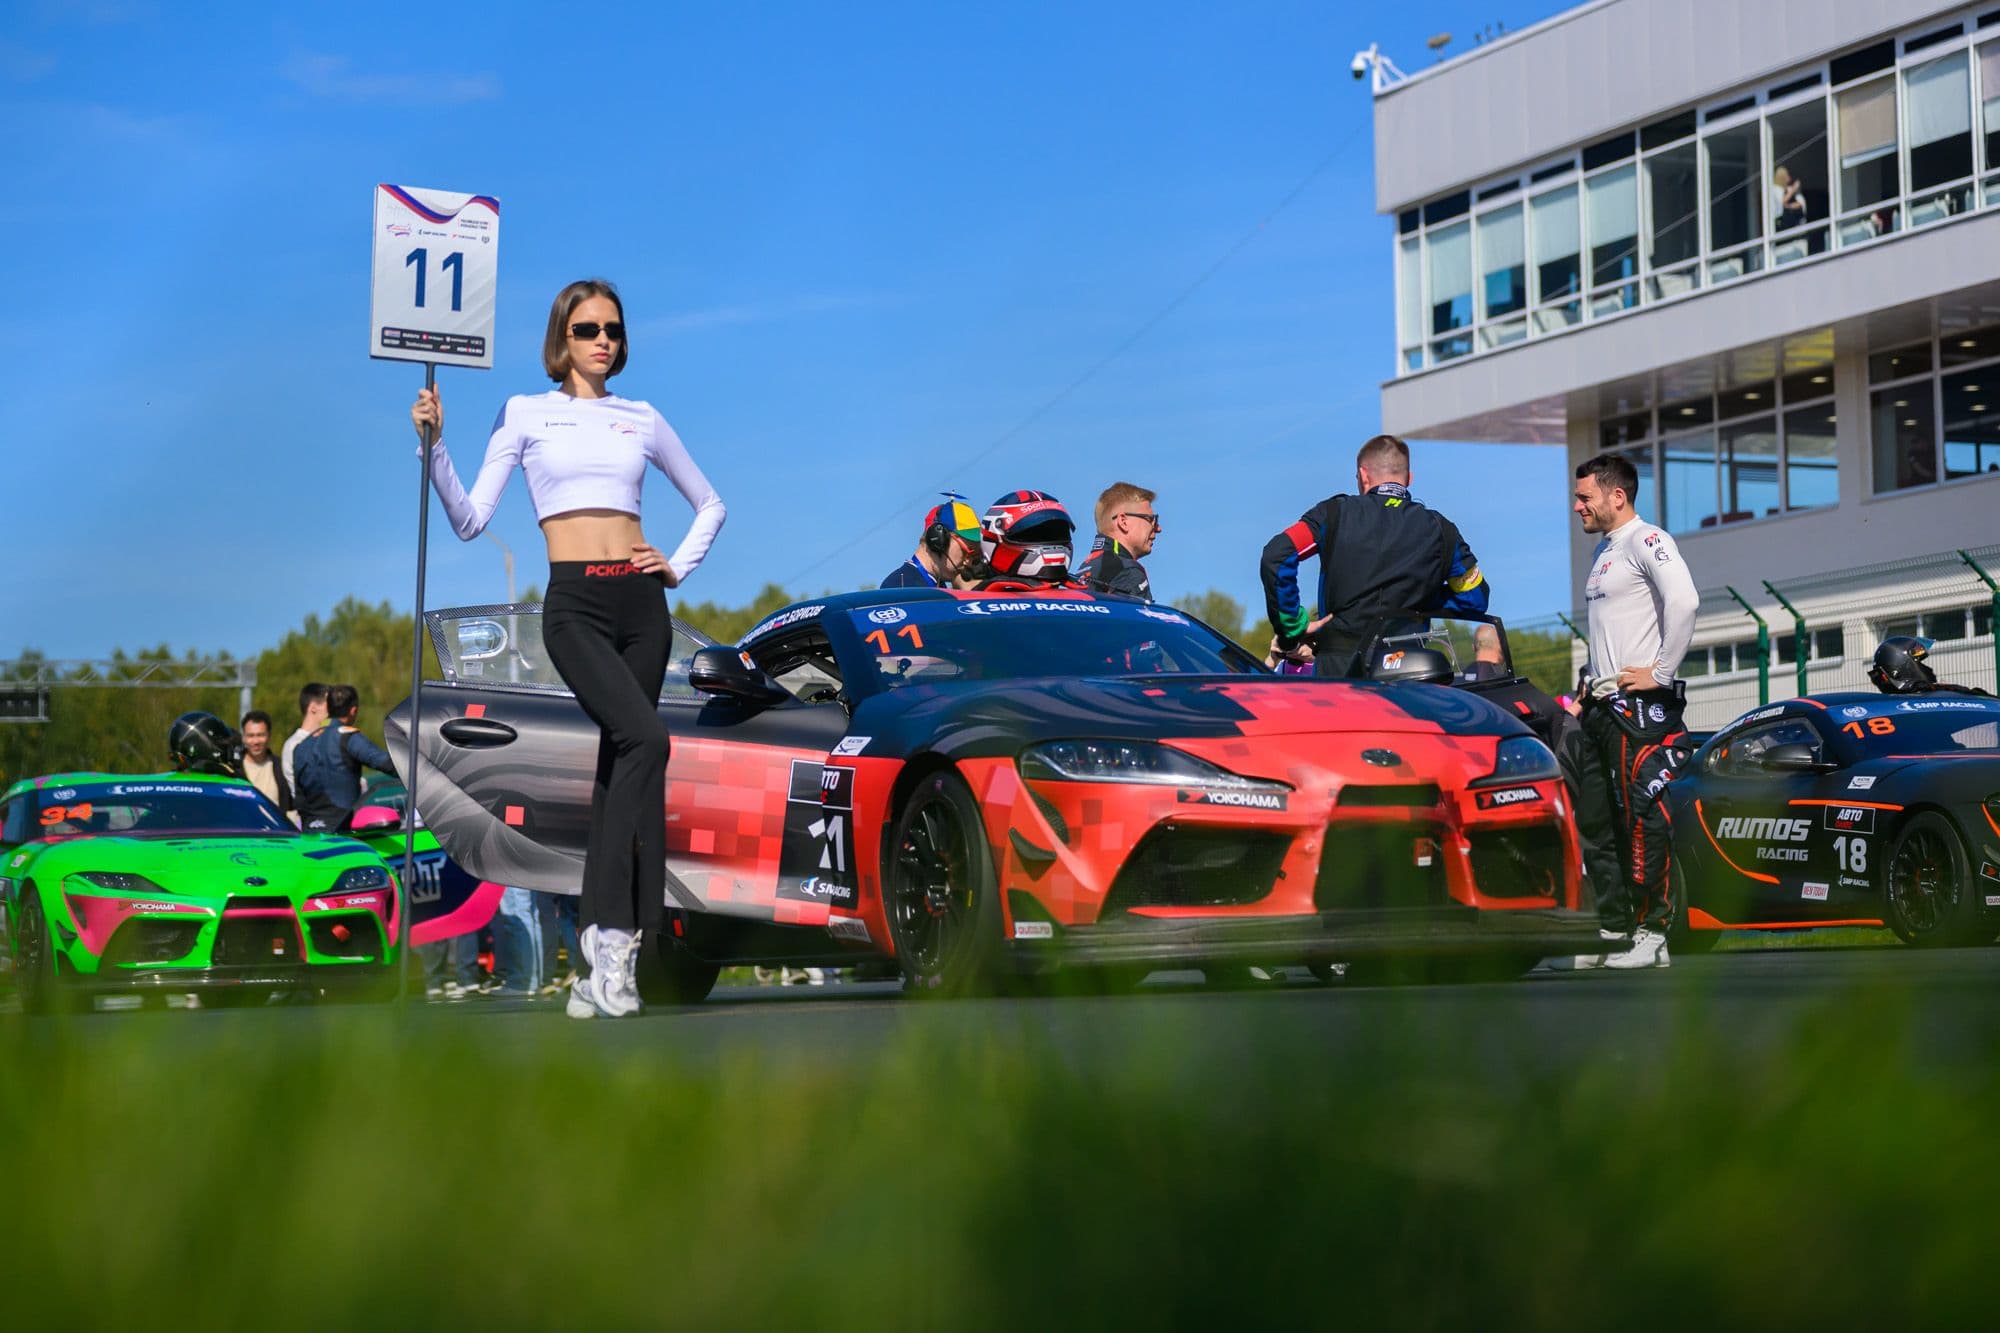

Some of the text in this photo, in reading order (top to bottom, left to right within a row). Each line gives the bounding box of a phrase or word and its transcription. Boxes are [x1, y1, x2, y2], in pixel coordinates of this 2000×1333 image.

[406, 248, 464, 312] 11
[987, 602, 1111, 614] SMP RACING
[864, 623, 924, 655] 11
[1913, 701, 1986, 710] SMP RACING
[1841, 716, 1896, 740] 18
[125, 785, 204, 794] SMP RACING
[1491, 788, 1539, 805] YOKOHAMA
[1206, 791, 1282, 809] YOKOHAMA
[39, 803, 93, 826] 34
[1836, 808, 1863, 823] АВТО
[1716, 816, 1812, 842] RUMOS
[1756, 847, 1809, 862] RACING
[1832, 836, 1867, 874] 18
[132, 902, 176, 912] YOKOHAMA
